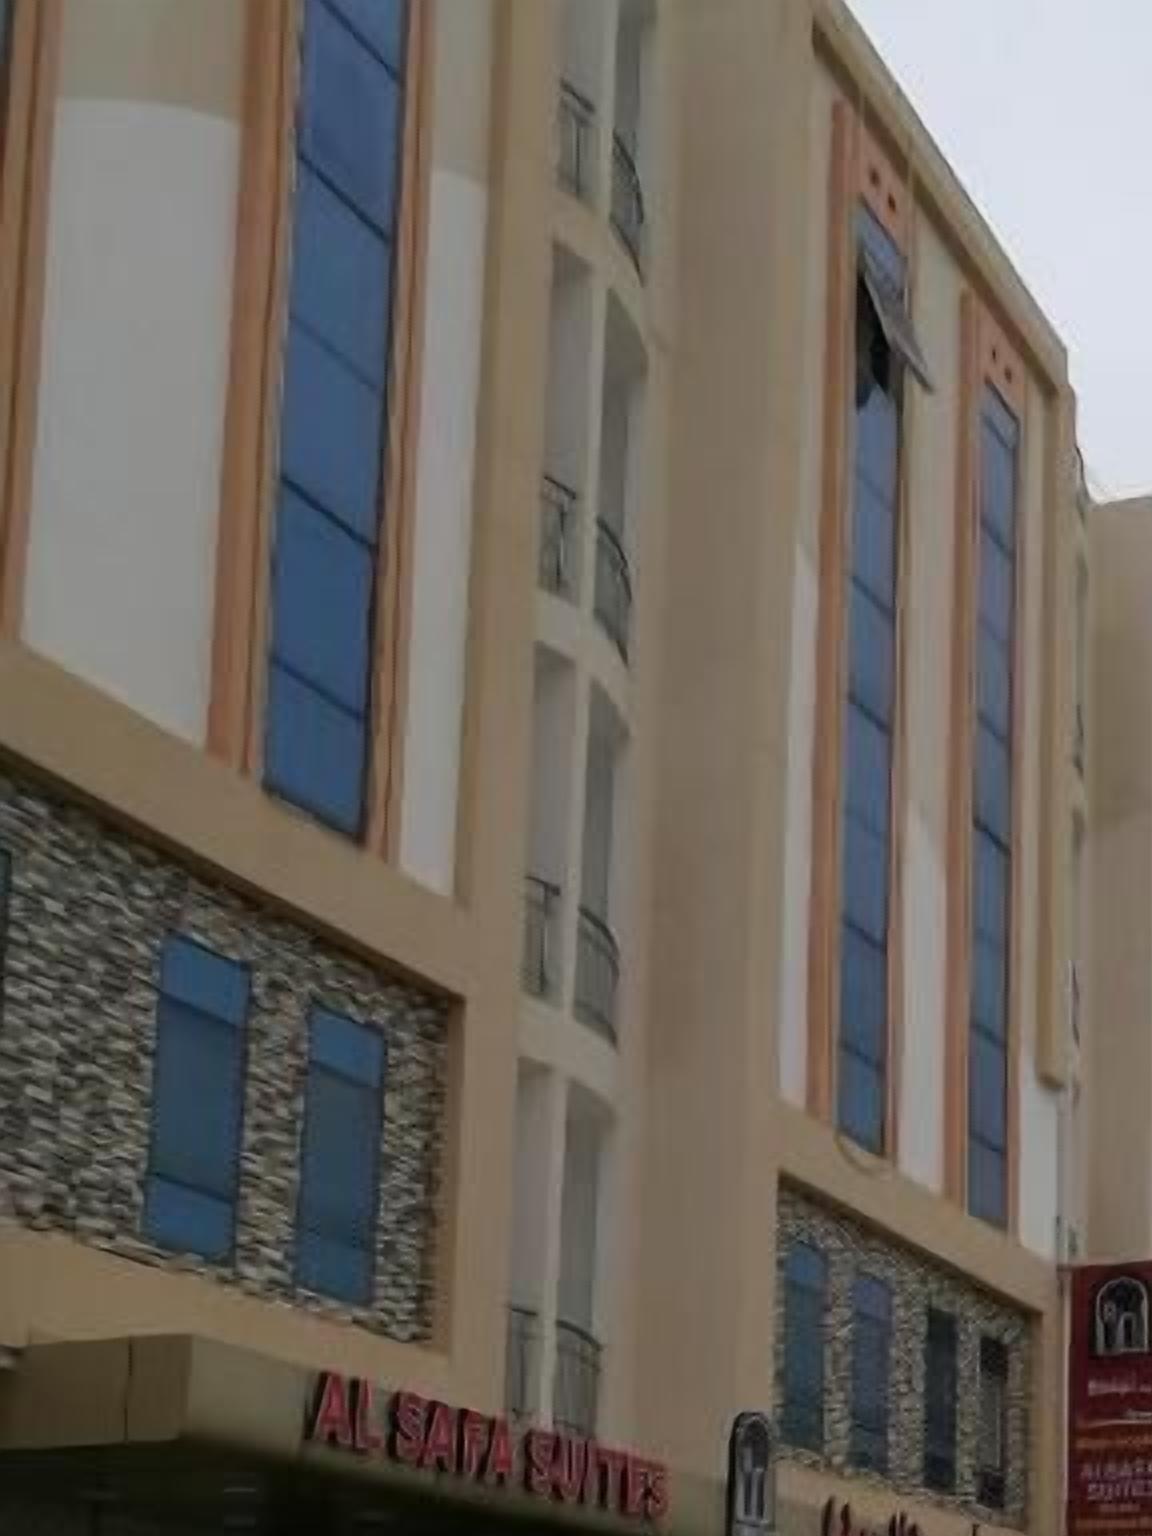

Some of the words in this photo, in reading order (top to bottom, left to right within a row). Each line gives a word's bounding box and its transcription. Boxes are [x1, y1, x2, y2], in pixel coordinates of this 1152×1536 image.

[308, 1371, 382, 1455] AL
[391, 1391, 513, 1482] SAFA
[525, 1429, 670, 1522] SUITES
